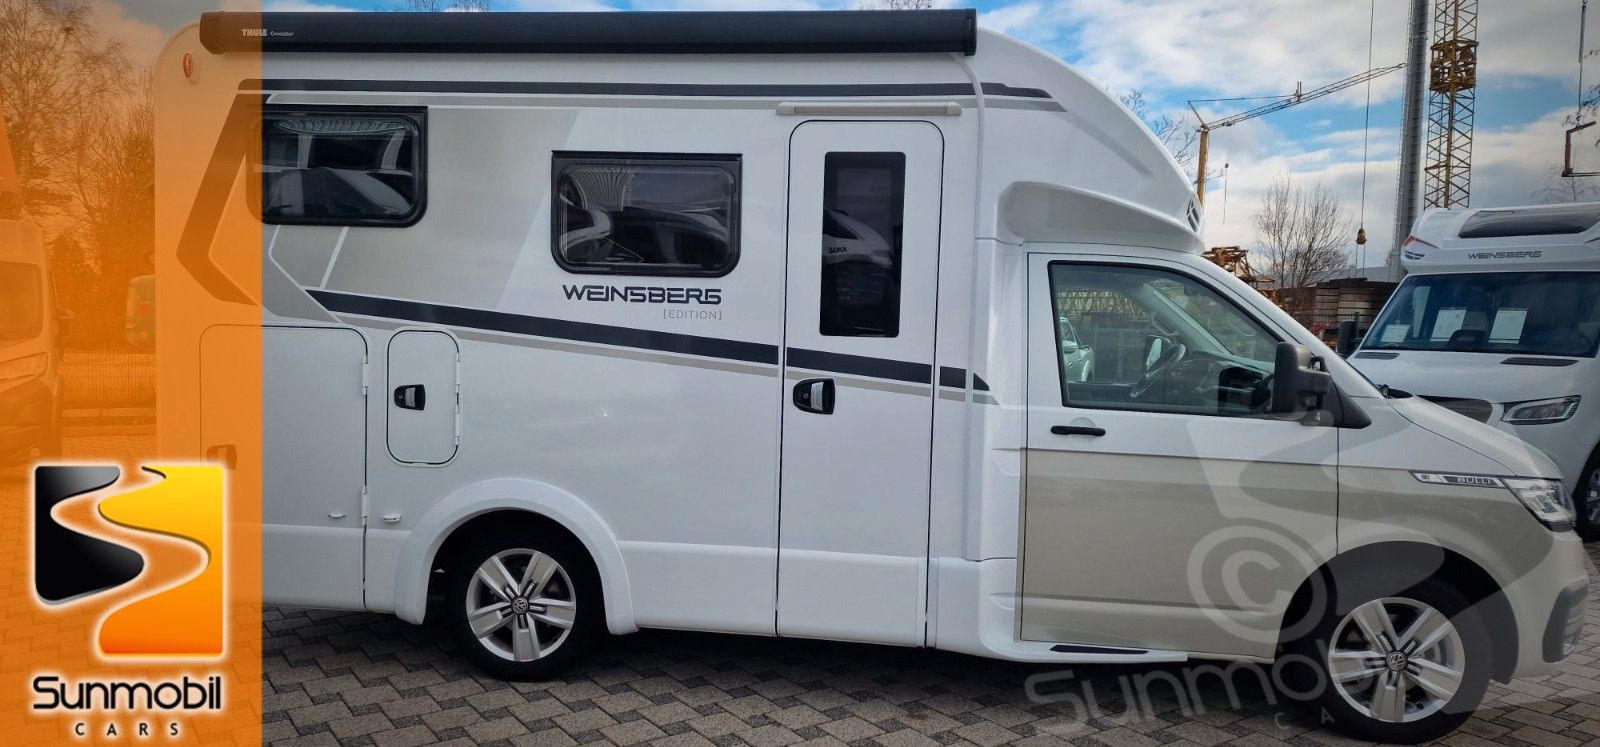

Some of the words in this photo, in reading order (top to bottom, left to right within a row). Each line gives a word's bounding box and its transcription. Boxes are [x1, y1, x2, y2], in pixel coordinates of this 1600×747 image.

[241, 28, 268, 37] THULE
[1467, 250, 1544, 260] WEINSBERG
[562, 284, 722, 305] WEINSBERG
[663, 309, 722, 321] [EDITION]
